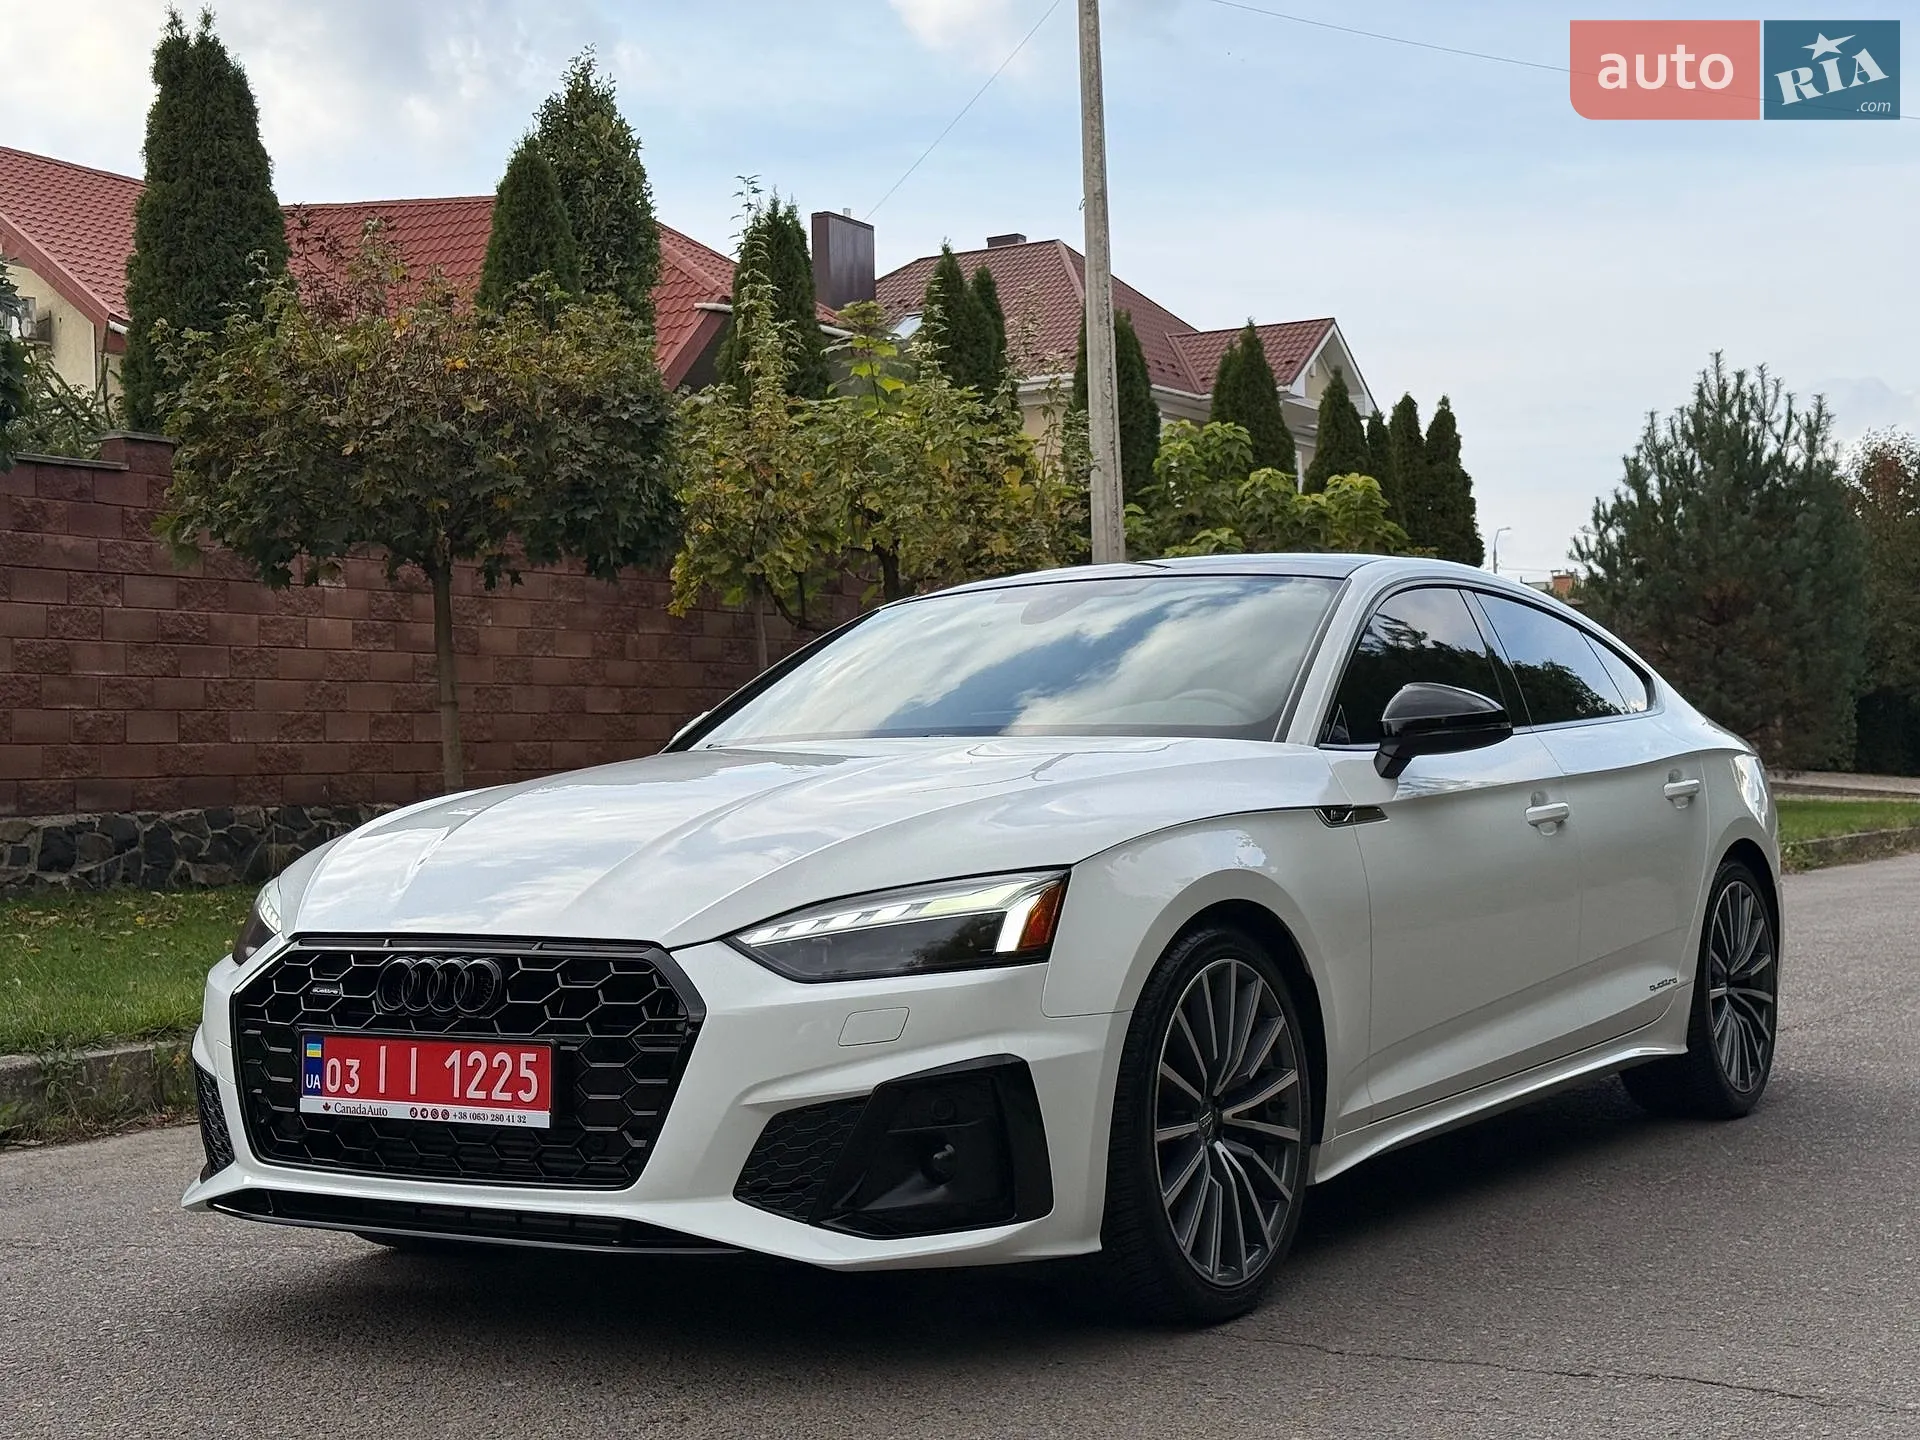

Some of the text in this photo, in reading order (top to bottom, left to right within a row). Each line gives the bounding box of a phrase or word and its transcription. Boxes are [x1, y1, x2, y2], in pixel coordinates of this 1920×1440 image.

[1649, 977, 1678, 992] quattro
[305, 1074, 321, 1090] UA
[325, 1057, 361, 1094] 03
[443, 1049, 539, 1103] 1225
[453, 1111, 468, 1120] +38
[490, 1113, 505, 1123] 280
[506, 1114, 515, 1123] 41
[517, 1115, 527, 1124] 32
